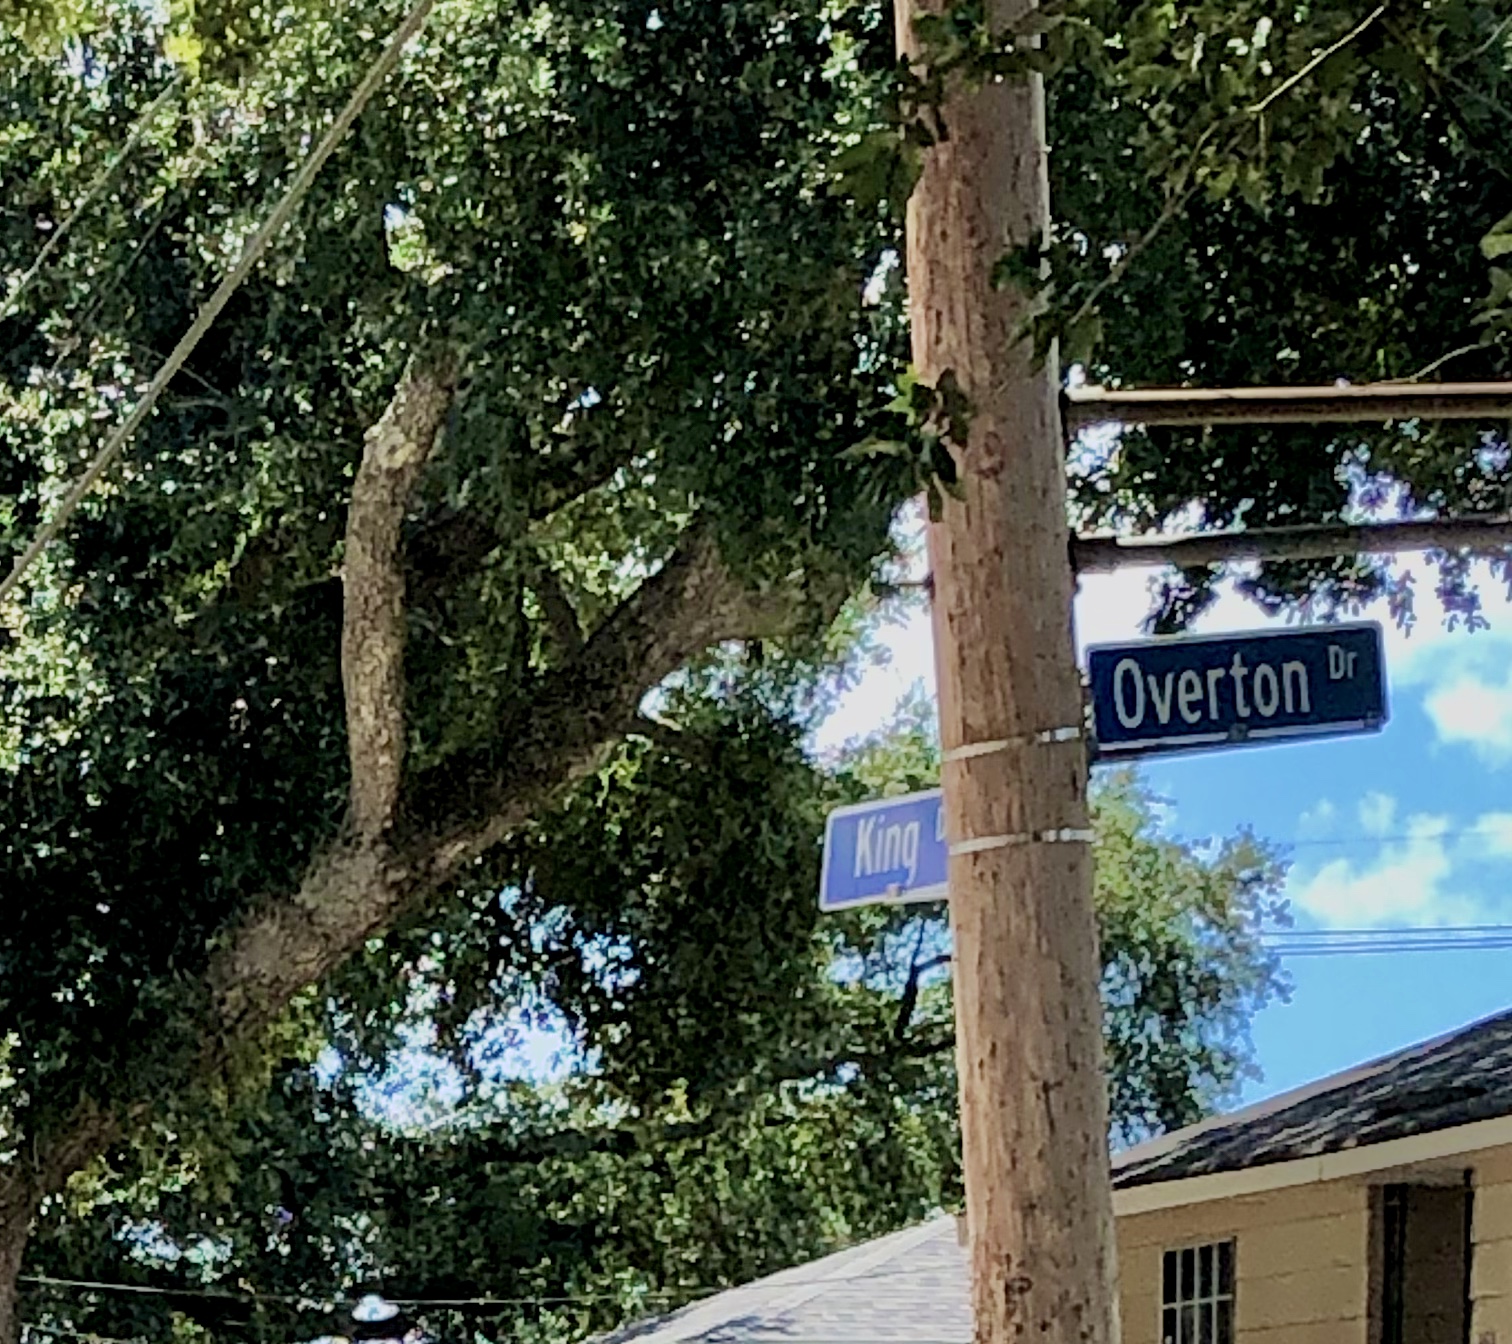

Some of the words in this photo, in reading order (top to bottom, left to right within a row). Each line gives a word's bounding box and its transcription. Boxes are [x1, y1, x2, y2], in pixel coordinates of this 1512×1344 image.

[1113, 651, 1311, 729] Overton
[1328, 644, 1358, 680] Dr
[853, 814, 920, 887] King
